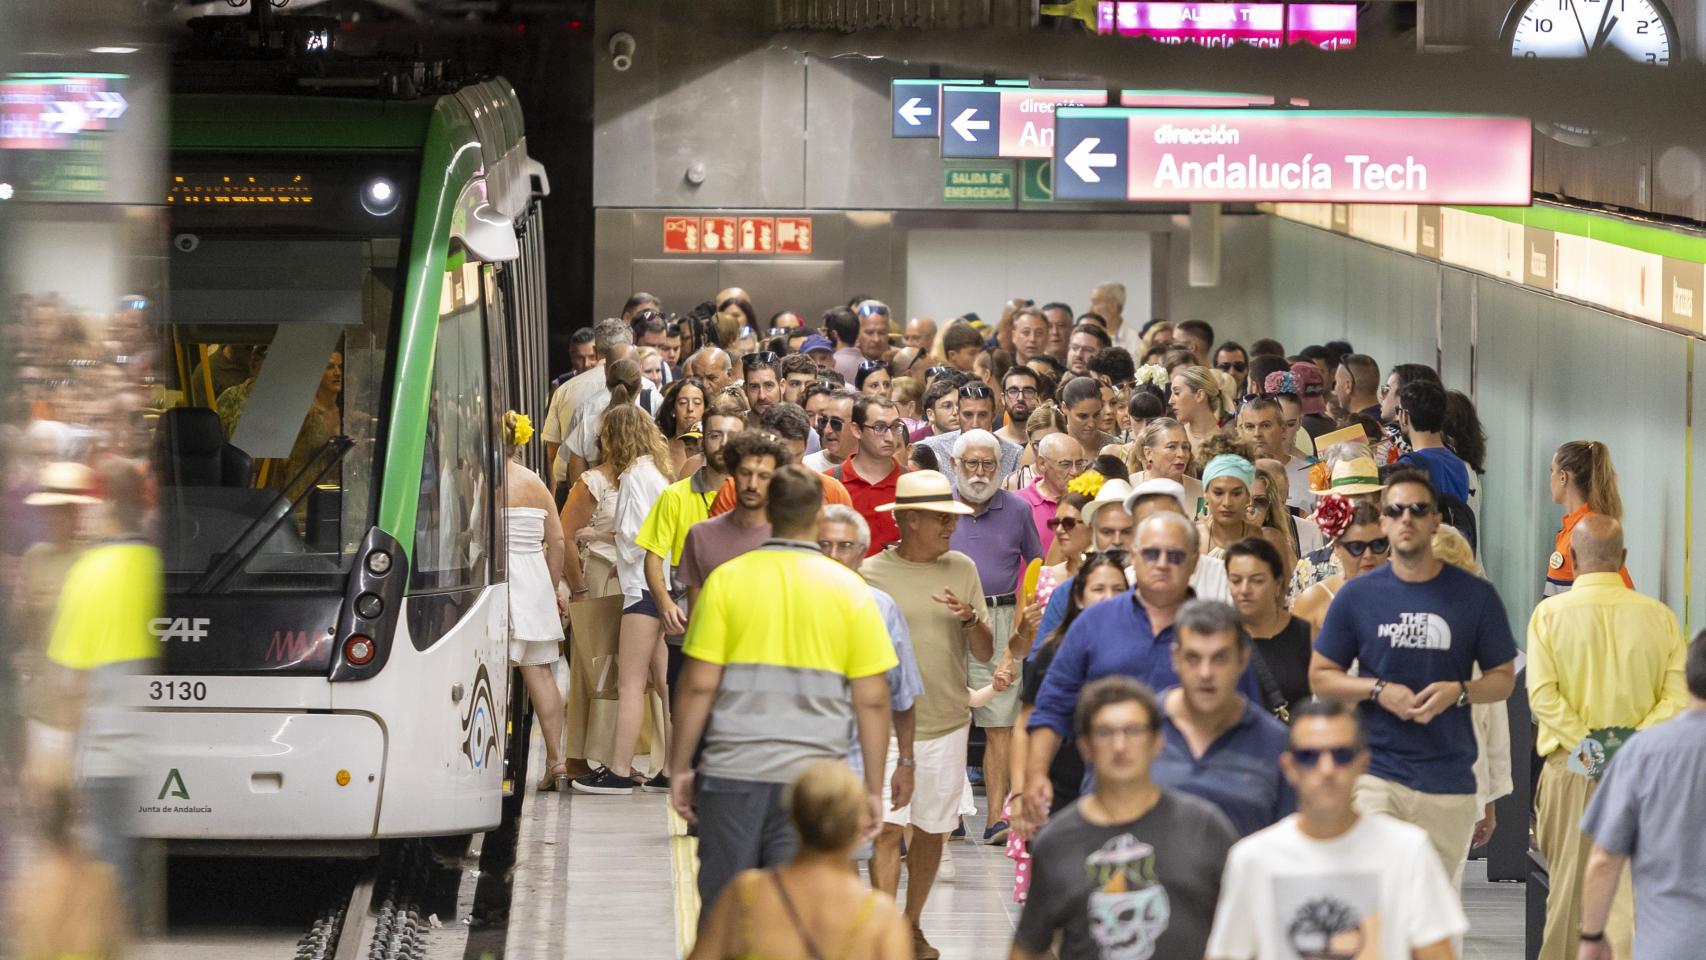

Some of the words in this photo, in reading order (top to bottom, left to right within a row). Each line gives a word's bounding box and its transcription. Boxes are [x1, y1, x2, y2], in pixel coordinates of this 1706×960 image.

[1535, 18, 1553, 33] 10
[1637, 20, 1648, 34] 2
[1019, 98, 1085, 113] direc
[1153, 124, 1240, 145] dirección
[952, 172, 986, 184] SALIDA
[989, 173, 1003, 184] DE
[1153, 153, 1332, 190] Andalucía
[1344, 154, 1427, 190] Tech
[944, 187, 1011, 199] EMERGENCIA
[1399, 612, 1428, 624] THE
[147, 617, 210, 642] CAF
[1377, 623, 1427, 638] NORTH
[1390, 635, 1427, 649] FACE
[149, 680, 207, 701] 3130
[138, 805, 161, 813] Junta
[162, 805, 172, 813] de
